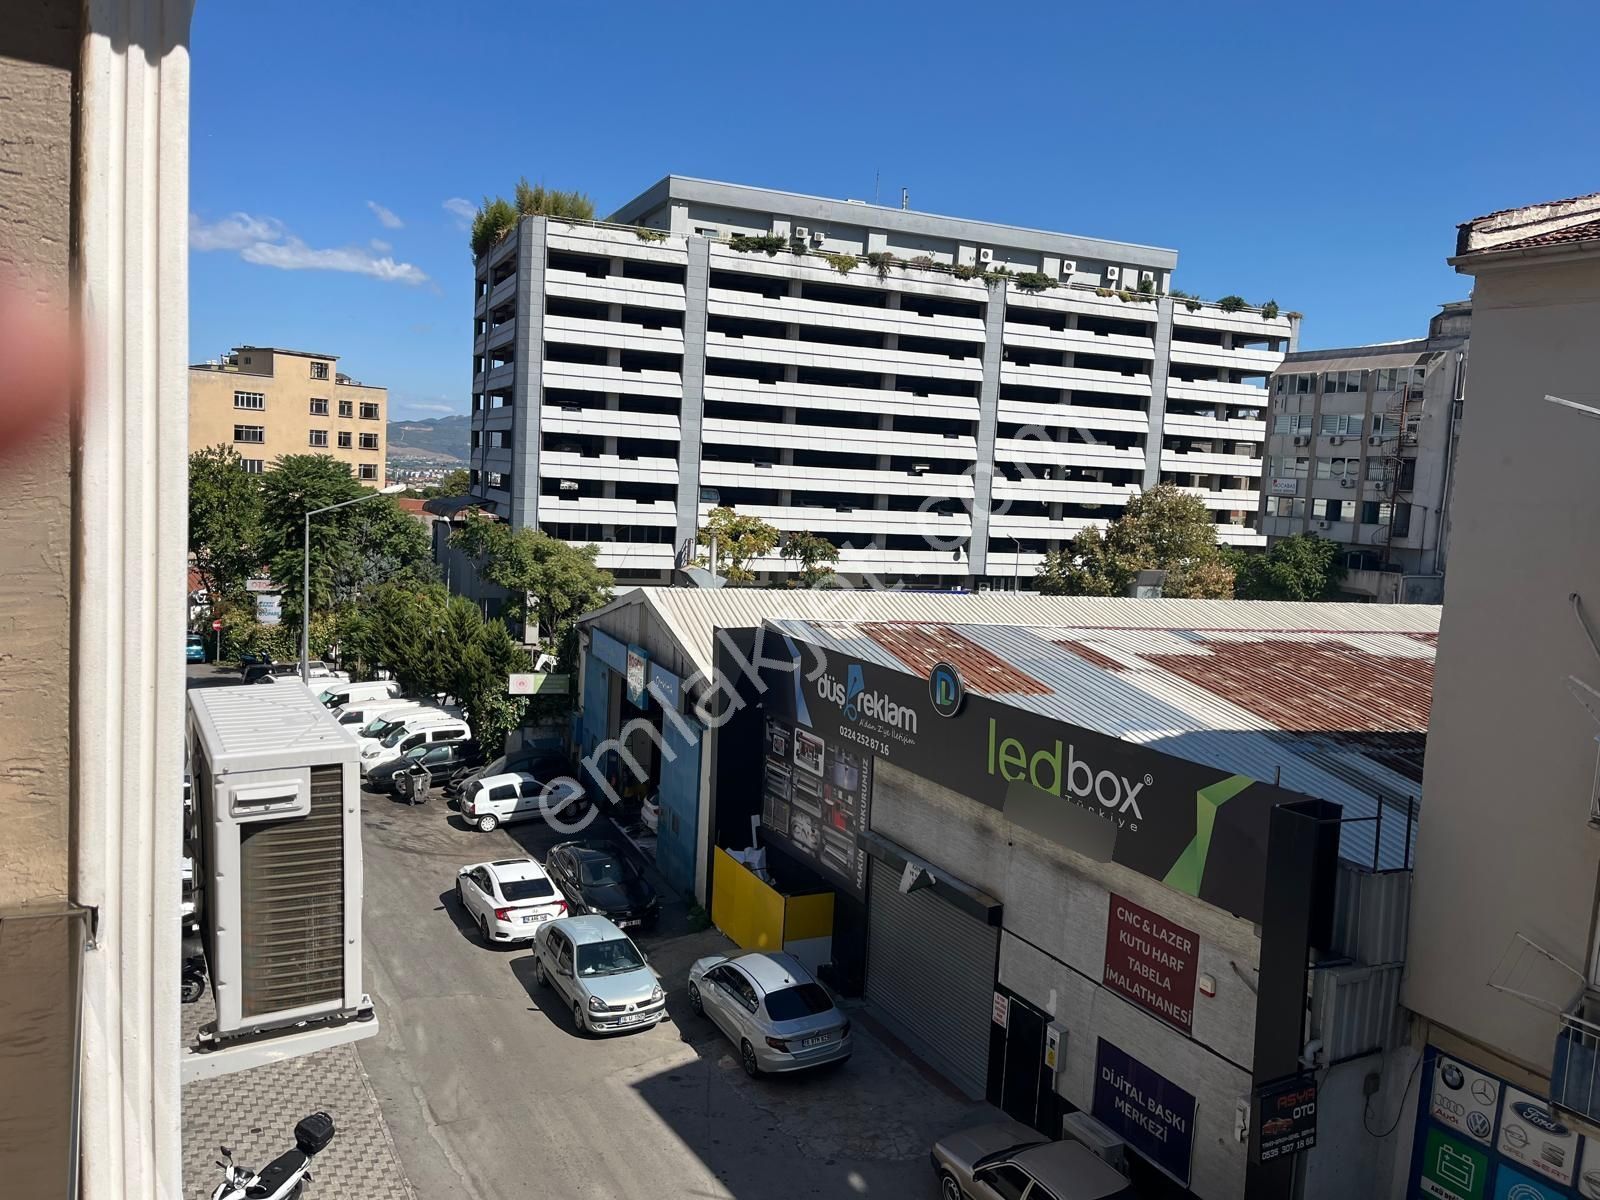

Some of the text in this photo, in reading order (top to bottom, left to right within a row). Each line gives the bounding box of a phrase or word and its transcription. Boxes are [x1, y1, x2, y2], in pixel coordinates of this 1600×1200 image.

[817, 673, 917, 734] düş reklam
[839, 725, 890, 756] 0224 252 87 16
[1116, 906, 1192, 955] CNC & LAZER
[1119, 929, 1185, 973] KUTU HARF
[1105, 963, 1193, 1027] İMALATHANESİ
[1127, 955, 1172, 991] TABELA
[1102, 1066, 1185, 1134] DİJİTAL BASKI
[1114, 1095, 1168, 1143] MERKEZİ
[1293, 1102, 1315, 1120] OTO
[1522, 1106, 1557, 1131] Ford
